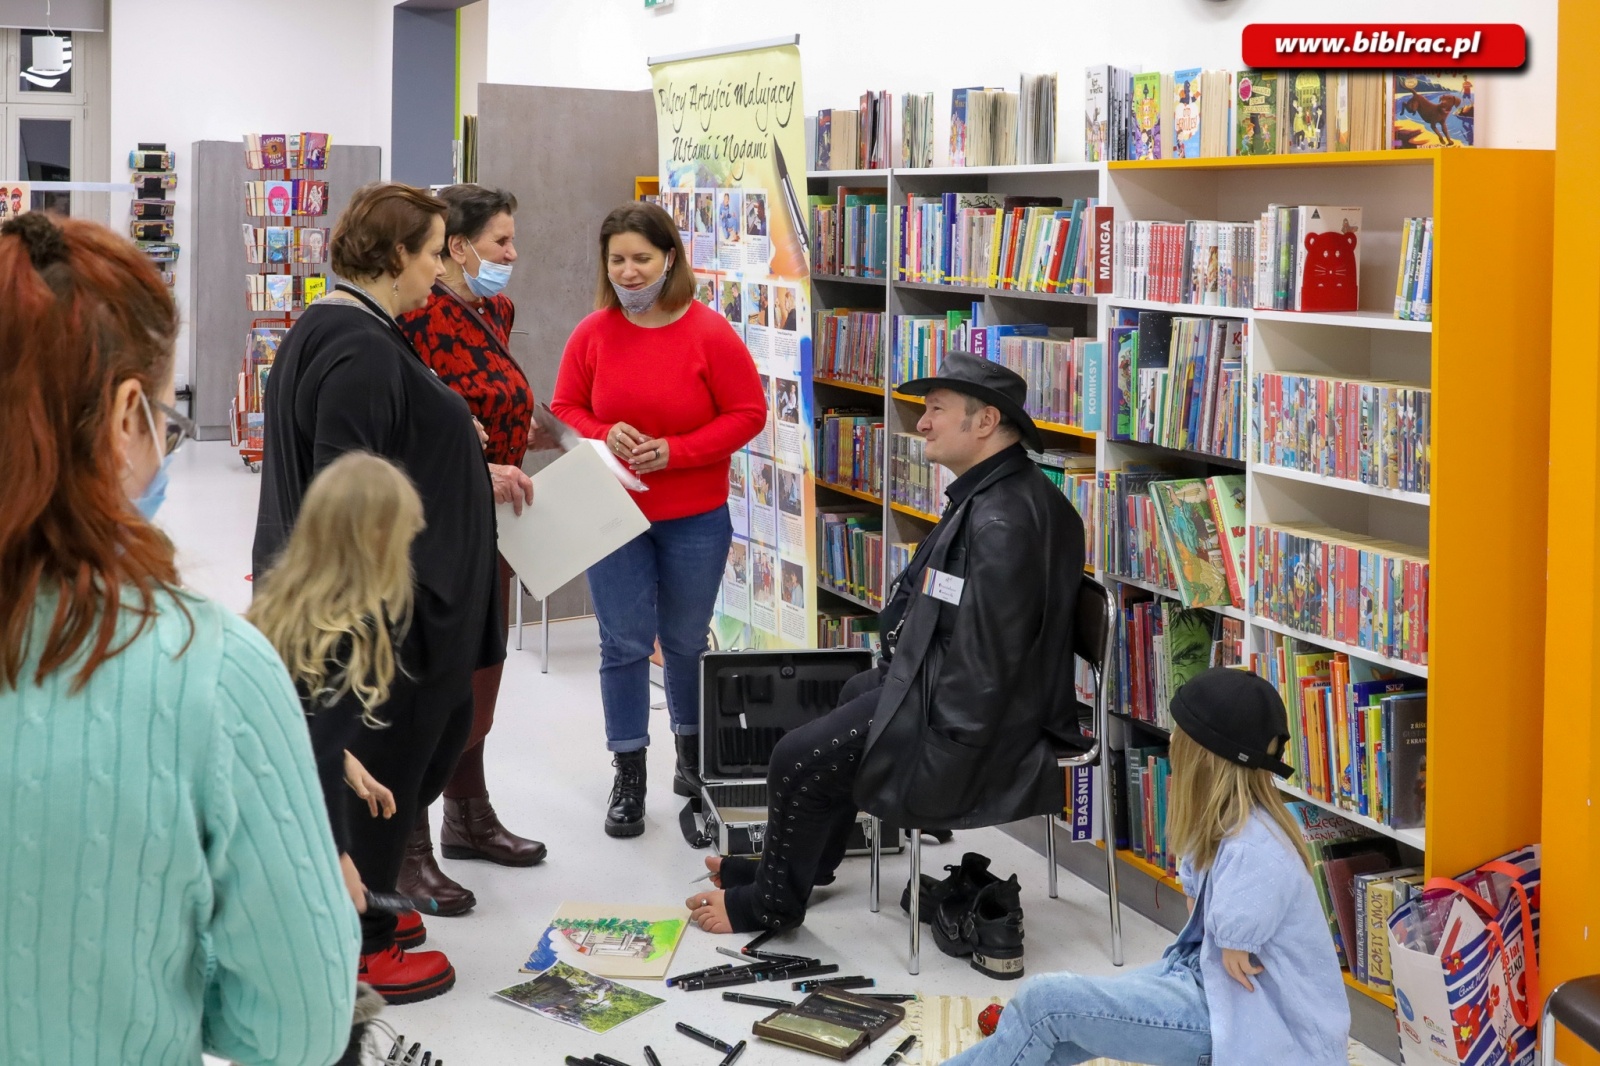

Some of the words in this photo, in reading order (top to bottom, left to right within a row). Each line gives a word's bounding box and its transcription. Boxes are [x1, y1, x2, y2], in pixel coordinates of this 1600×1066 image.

[689, 79, 732, 132] Artyści
[733, 72, 796, 132] Malujący
[672, 135, 713, 163] Ustami
[714, 135, 721, 160] i
[1099, 220, 1112, 280] MANGA
[1088, 358, 1098, 415] KOMIKSY
[1076, 766, 1089, 826] BAŚNIE
[1077, 830, 1086, 840] B
[1509, 942, 1520, 960] lat
